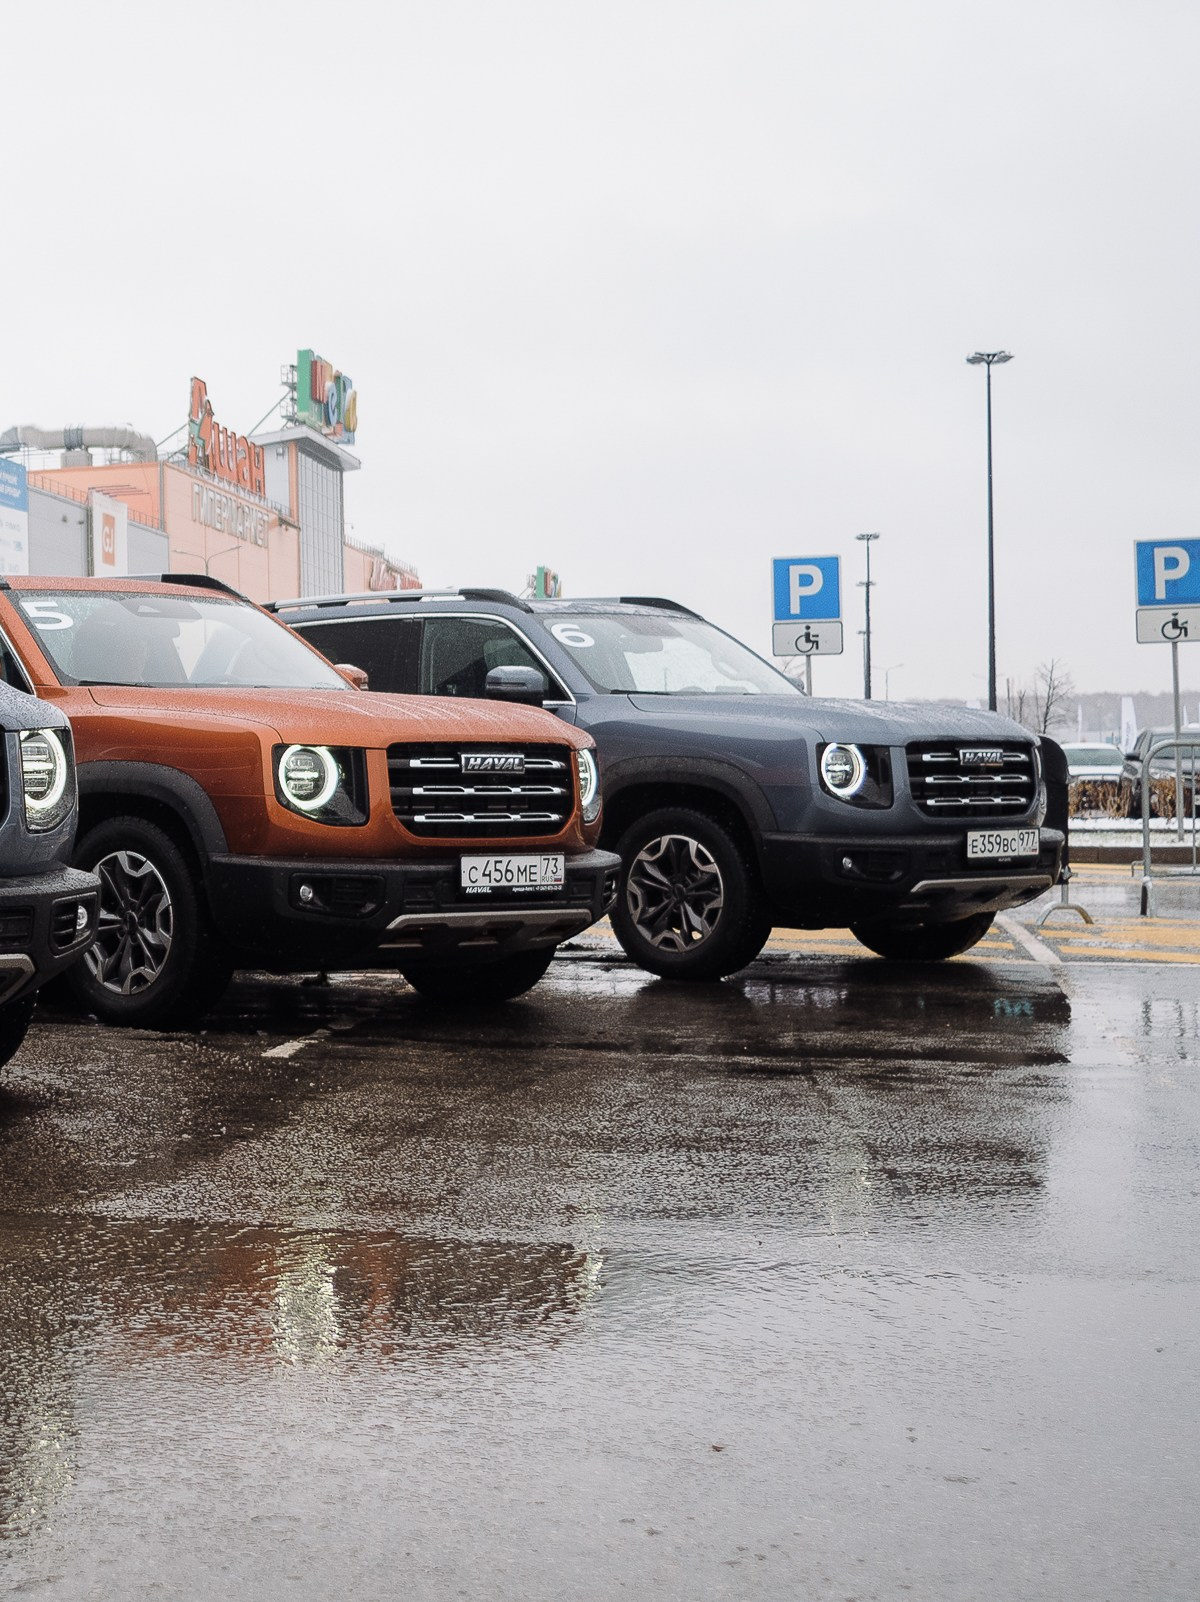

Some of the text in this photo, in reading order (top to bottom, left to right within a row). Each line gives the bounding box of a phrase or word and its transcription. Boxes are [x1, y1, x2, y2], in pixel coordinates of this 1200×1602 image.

[1153, 546, 1190, 600] P
[789, 565, 823, 615] P
[20, 601, 74, 630] 5
[551, 624, 594, 648] 6
[467, 757, 523, 770] HAVAL
[964, 751, 1003, 764] HAVAL
[1019, 832, 1036, 847] 977
[468, 858, 558, 884] С456МЕ 73
